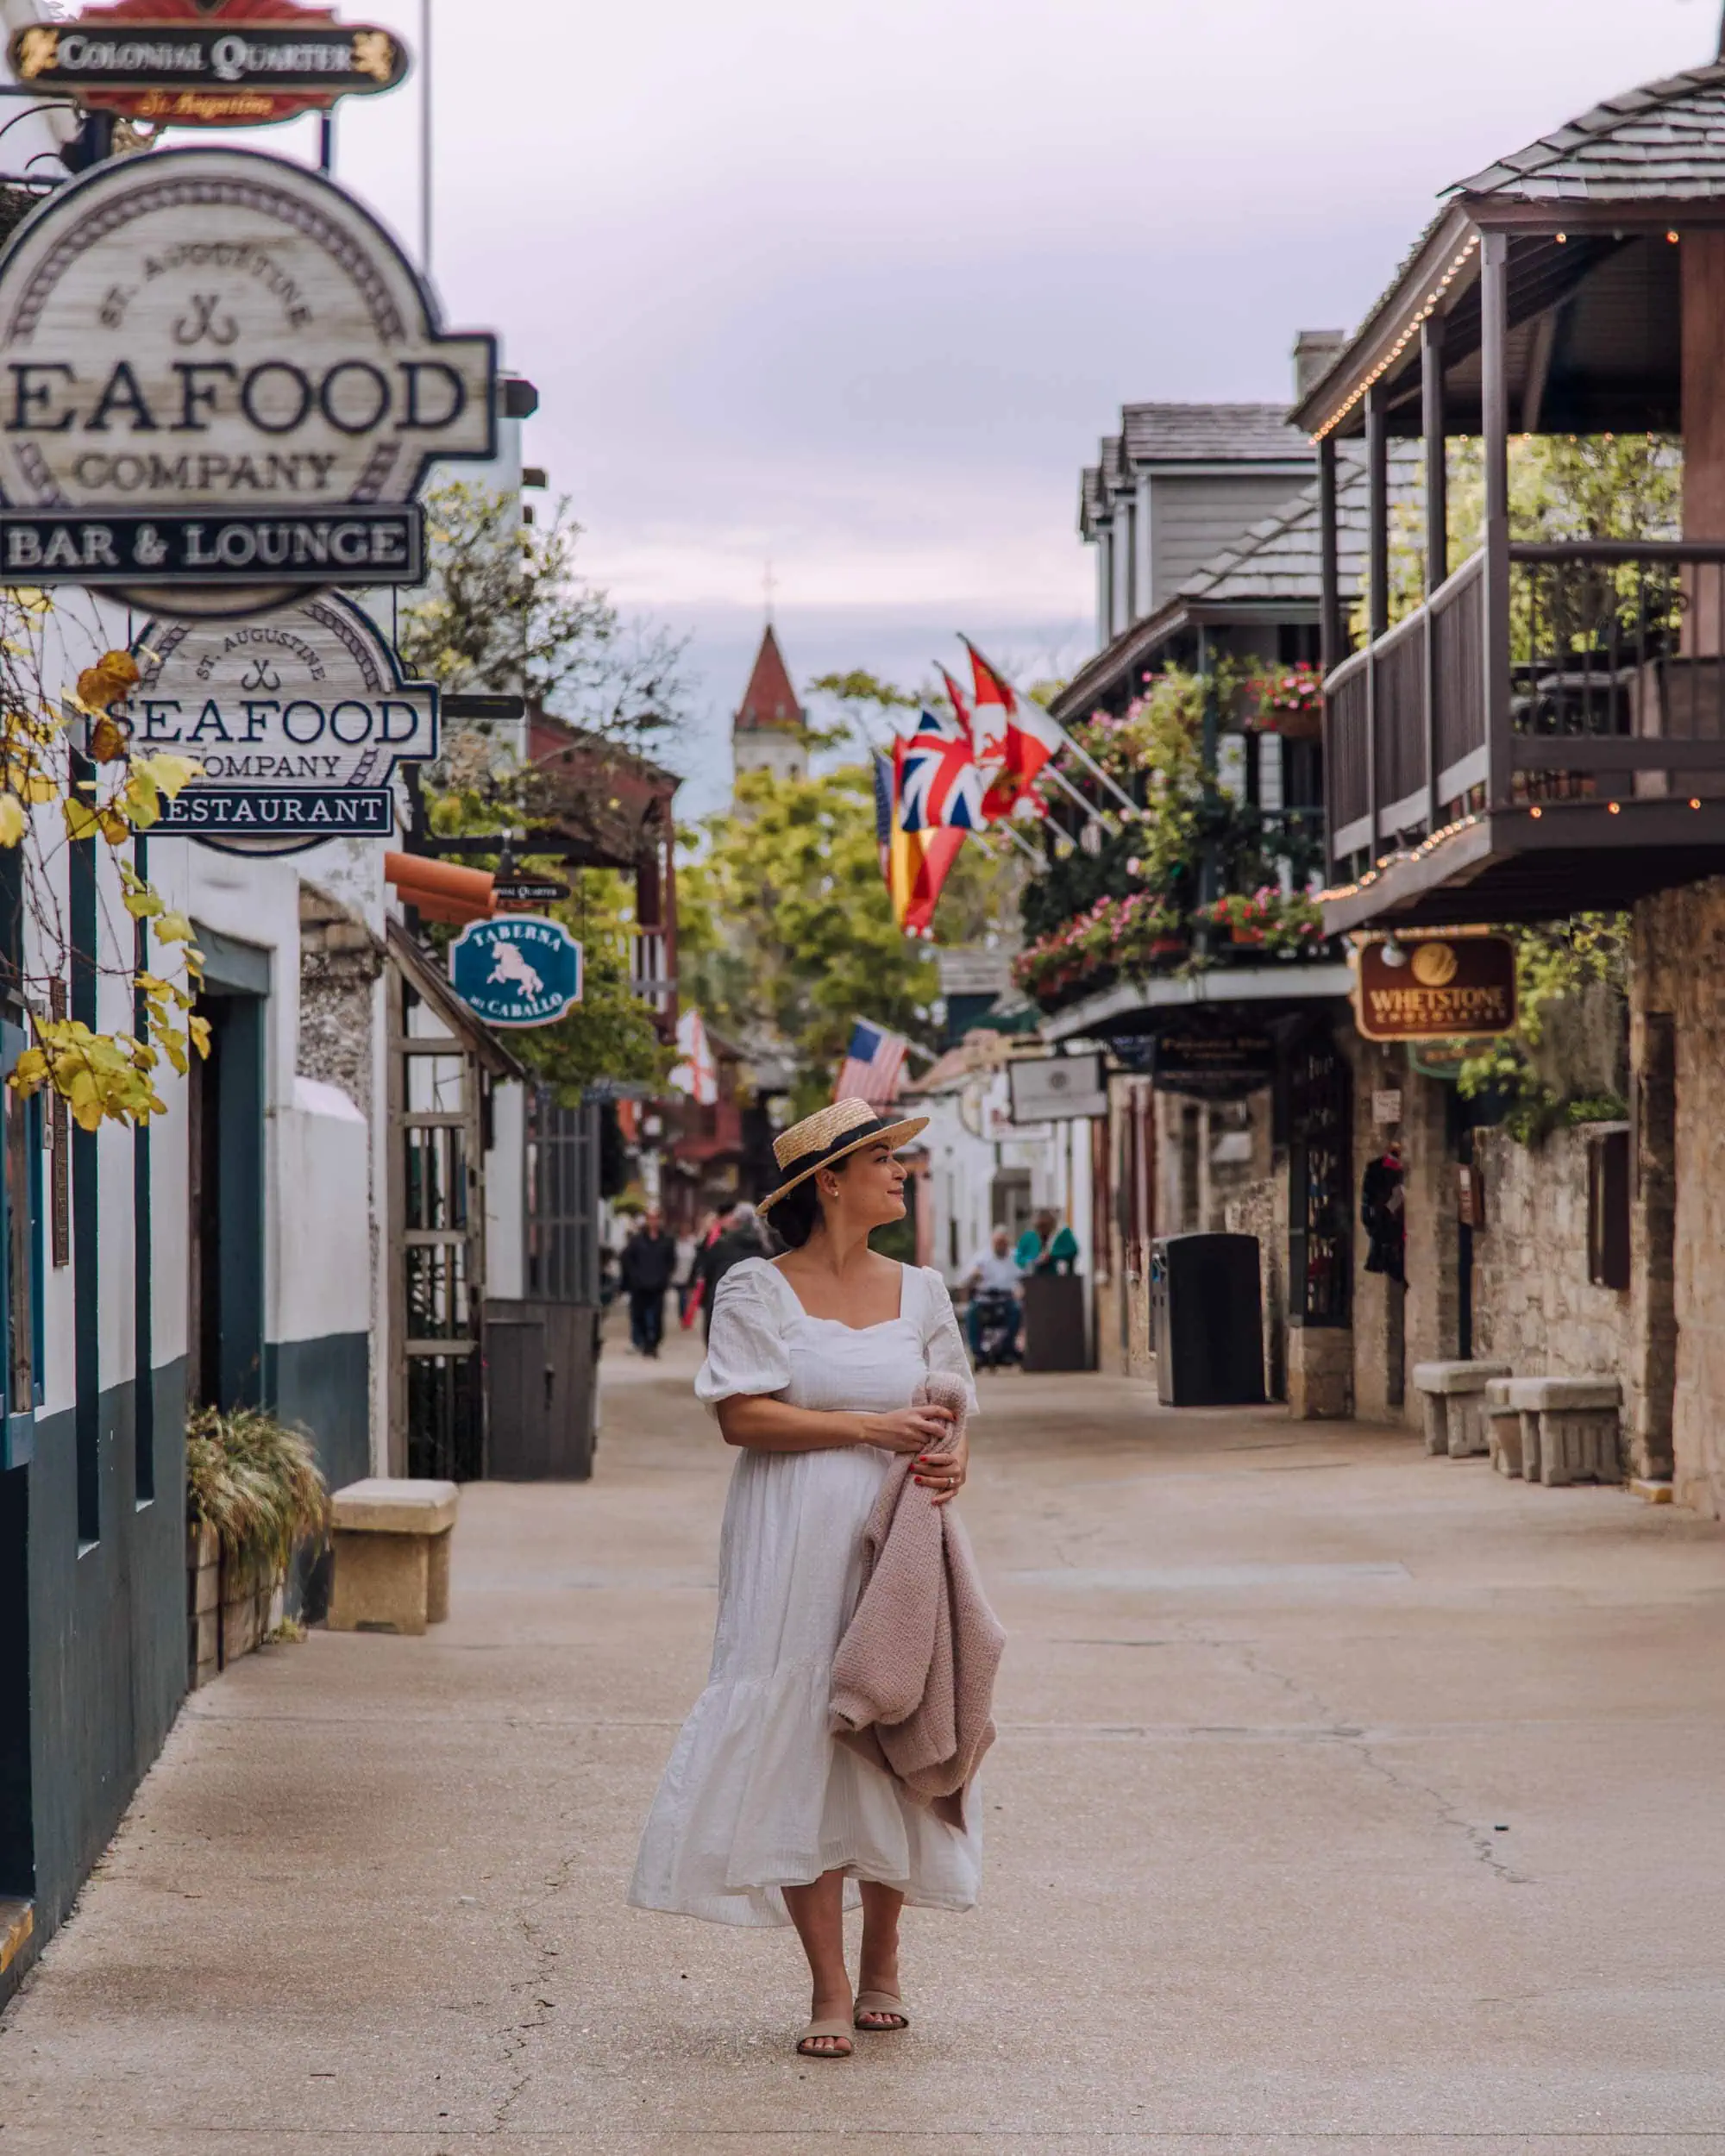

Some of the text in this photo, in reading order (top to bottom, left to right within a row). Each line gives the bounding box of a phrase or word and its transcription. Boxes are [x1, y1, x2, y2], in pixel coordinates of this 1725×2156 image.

[58, 35, 354, 81] COLONIAL QUARTER
[143, 243, 313, 329] AUGUSTINE
[3, 360, 467, 433] EAFOOD
[73, 451, 340, 492] COMPANY
[7, 523, 406, 567] BAR & LOUNGE
[223, 627, 326, 681] AUGUSTINE
[106, 699, 419, 744] SEAFOOD
[187, 755, 342, 778] OMPANY
[154, 798, 383, 822] ESTAURANT
[473, 924, 561, 952] TABERNA
[487, 993, 563, 1018] CABALLO
[1370, 987, 1505, 1012] WHETSTONE
